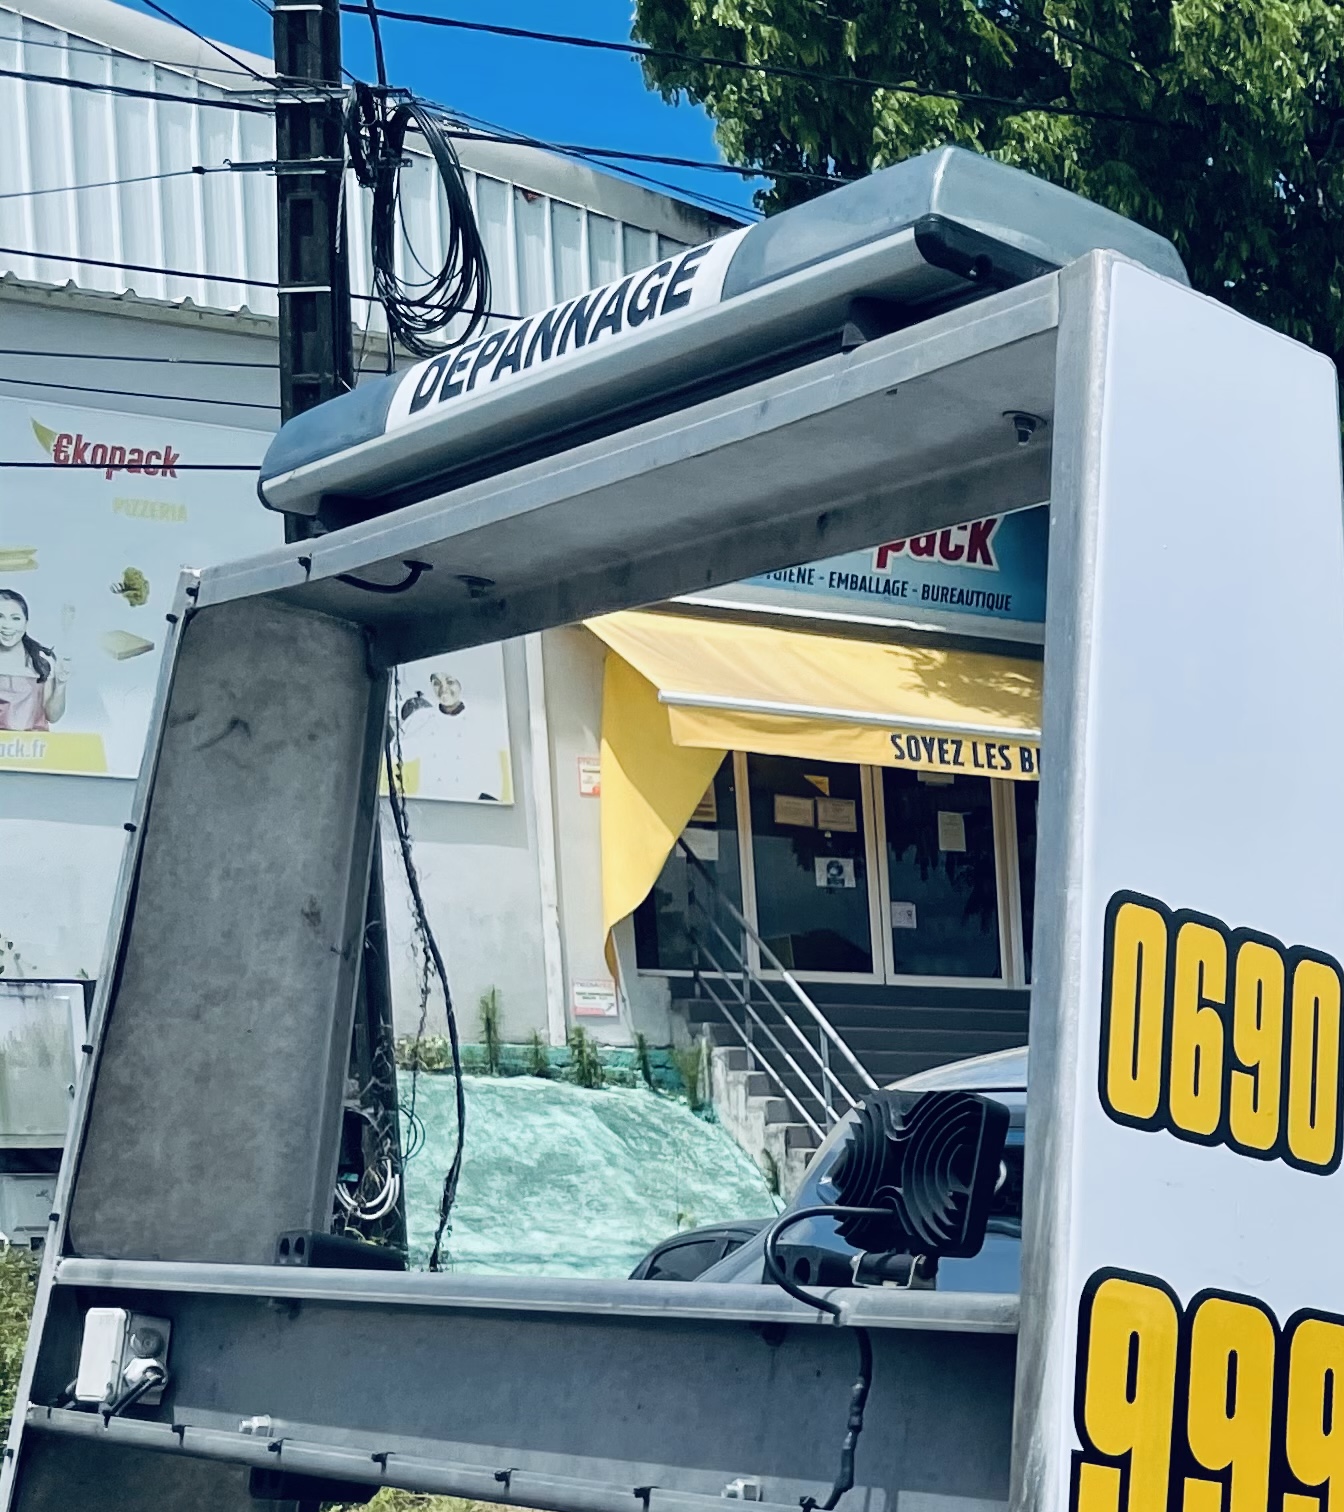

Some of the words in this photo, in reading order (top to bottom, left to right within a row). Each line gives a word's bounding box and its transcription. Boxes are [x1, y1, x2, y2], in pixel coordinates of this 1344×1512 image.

[408, 243, 716, 415] DEPANNAGE
[828, 570, 909, 598] EMBALLAGE
[921, 583, 1013, 612] BUREAUTIQUE
[890, 733, 965, 767] SOYEZ
[972, 741, 1012, 771] LES
